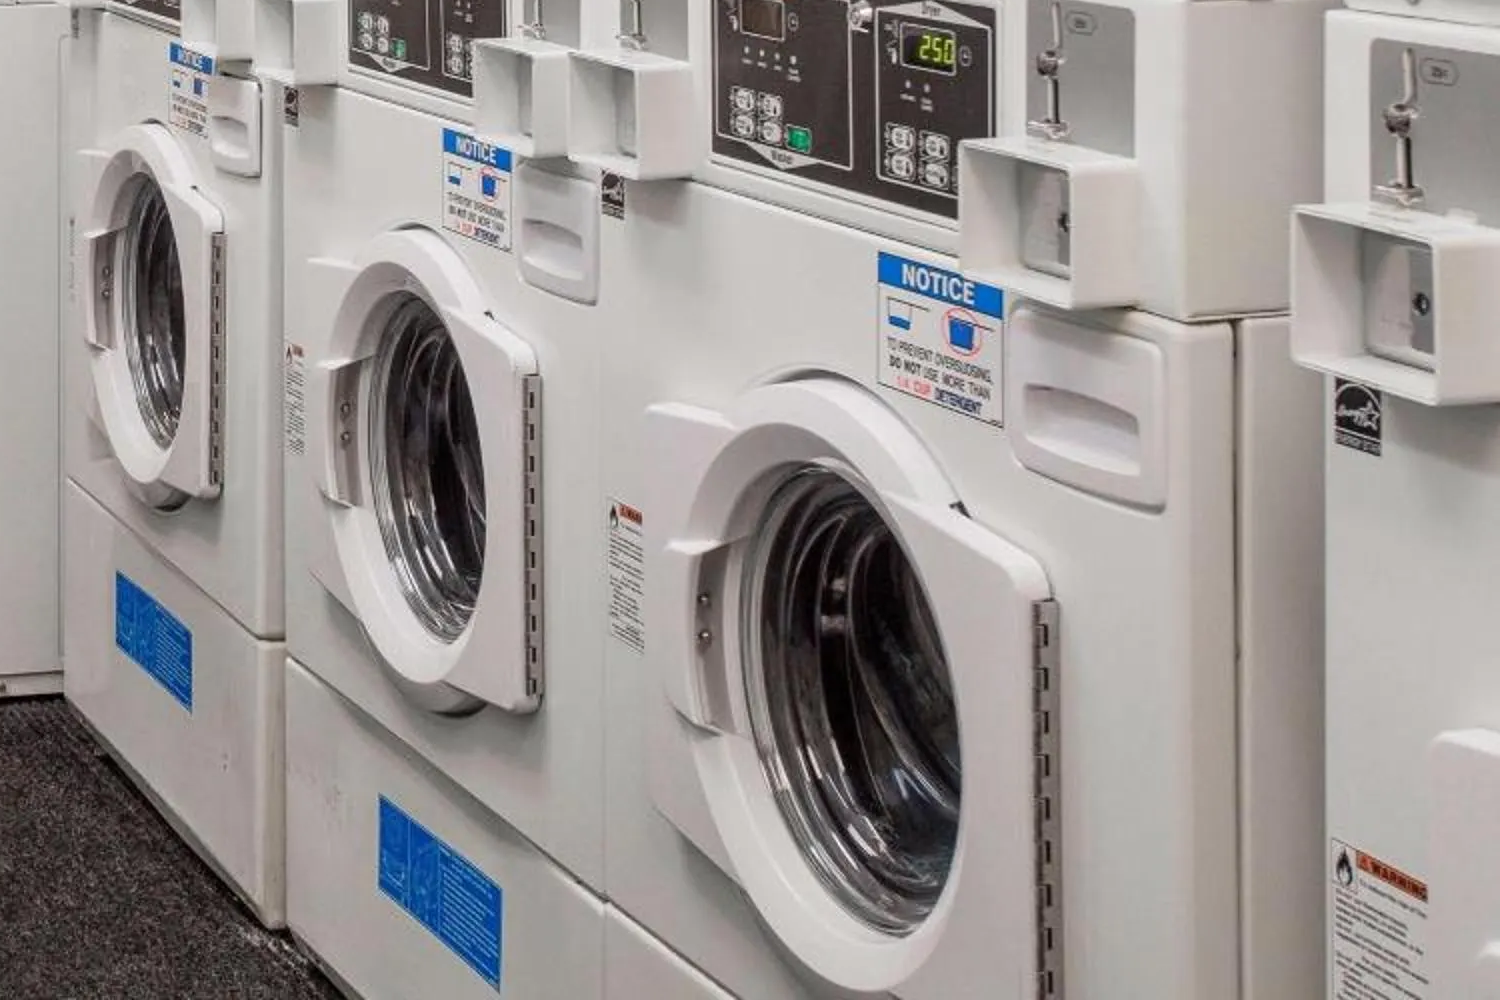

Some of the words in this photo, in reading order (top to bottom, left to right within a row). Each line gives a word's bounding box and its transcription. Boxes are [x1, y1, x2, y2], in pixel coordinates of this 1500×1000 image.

[919, 35, 956, 65] 250
[901, 263, 976, 306] NOTICE
[899, 340, 933, 362] PREVENT
[889, 355, 901, 367] DO
[903, 357, 921, 373] NOT
[923, 364, 938, 382] USE
[941, 372, 965, 392] MORE
[968, 382, 991, 400] THAN
